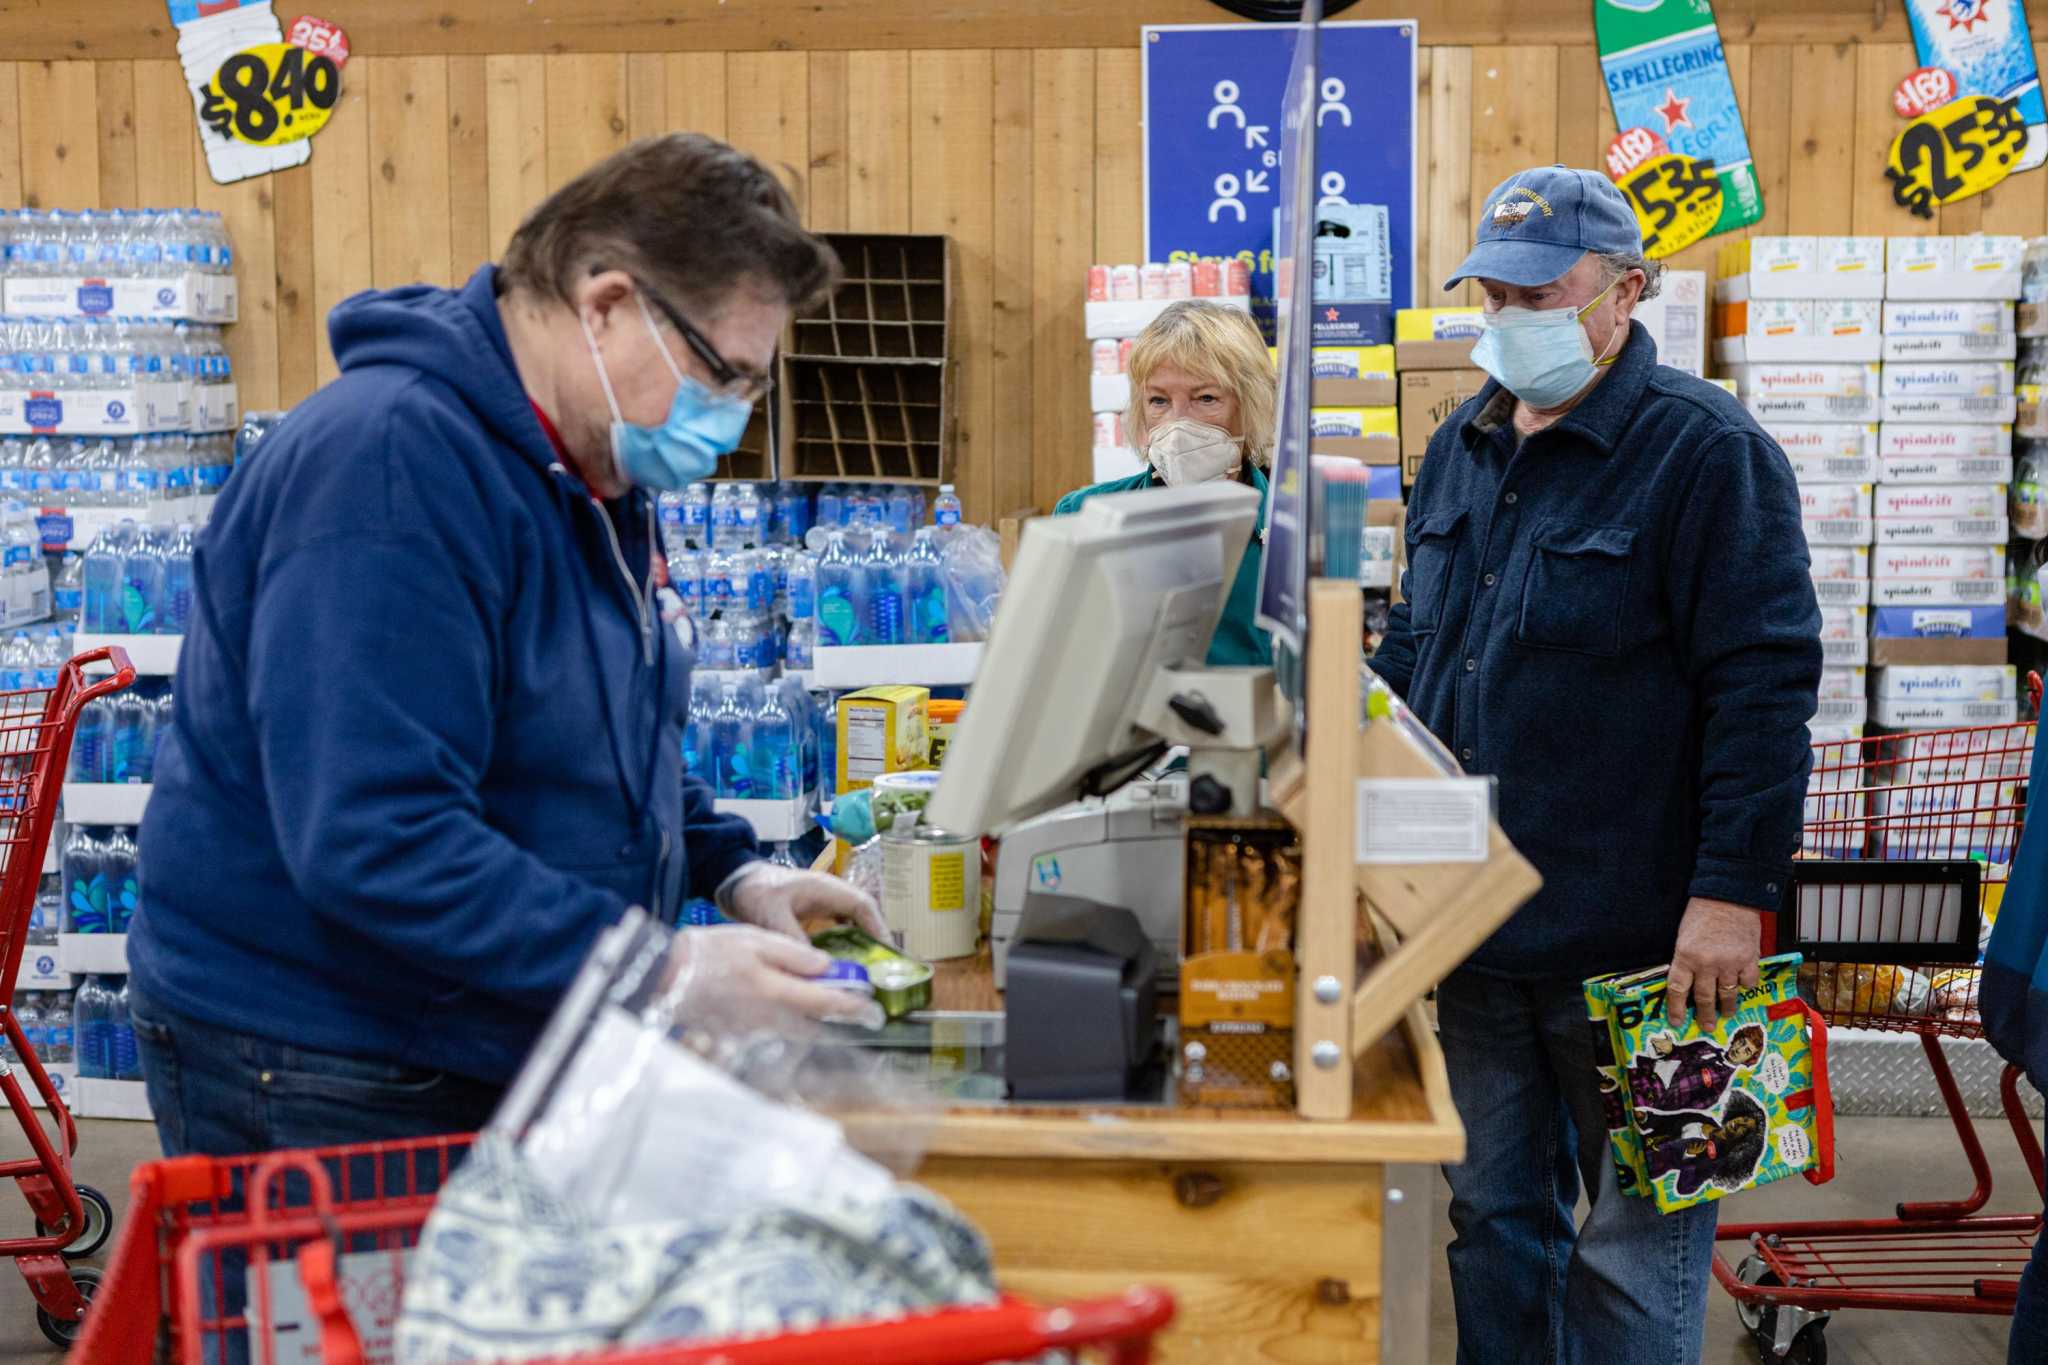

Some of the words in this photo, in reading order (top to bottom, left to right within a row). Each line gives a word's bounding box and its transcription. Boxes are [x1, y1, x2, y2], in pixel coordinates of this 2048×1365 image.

[199, 47, 338, 141] $8.40
[1885, 96, 2028, 218] $25.35
[1621, 160, 1722, 252] 5.35
[1896, 310, 1959, 328] spindrift
[1892, 340, 1942, 354] spindrift
[1760, 372, 1824, 388] spindrift
[1895, 373, 1959, 389] spindrift
[1757, 401, 1805, 413] spindrift
[1891, 403, 1940, 416] spindrift
[1776, 433, 1823, 446] indrift
[1893, 434, 1956, 450] spindrift
[1889, 465, 1937, 477] spindrift
[1888, 494, 1952, 511] spindrift
[1885, 526, 1934, 539] spindrift
[1888, 553, 1951, 573] spindrift
[1883, 586, 1932, 599] spindrift
[1899, 676, 1962, 693] spindrift
[1896, 710, 1944, 721] spindrift
